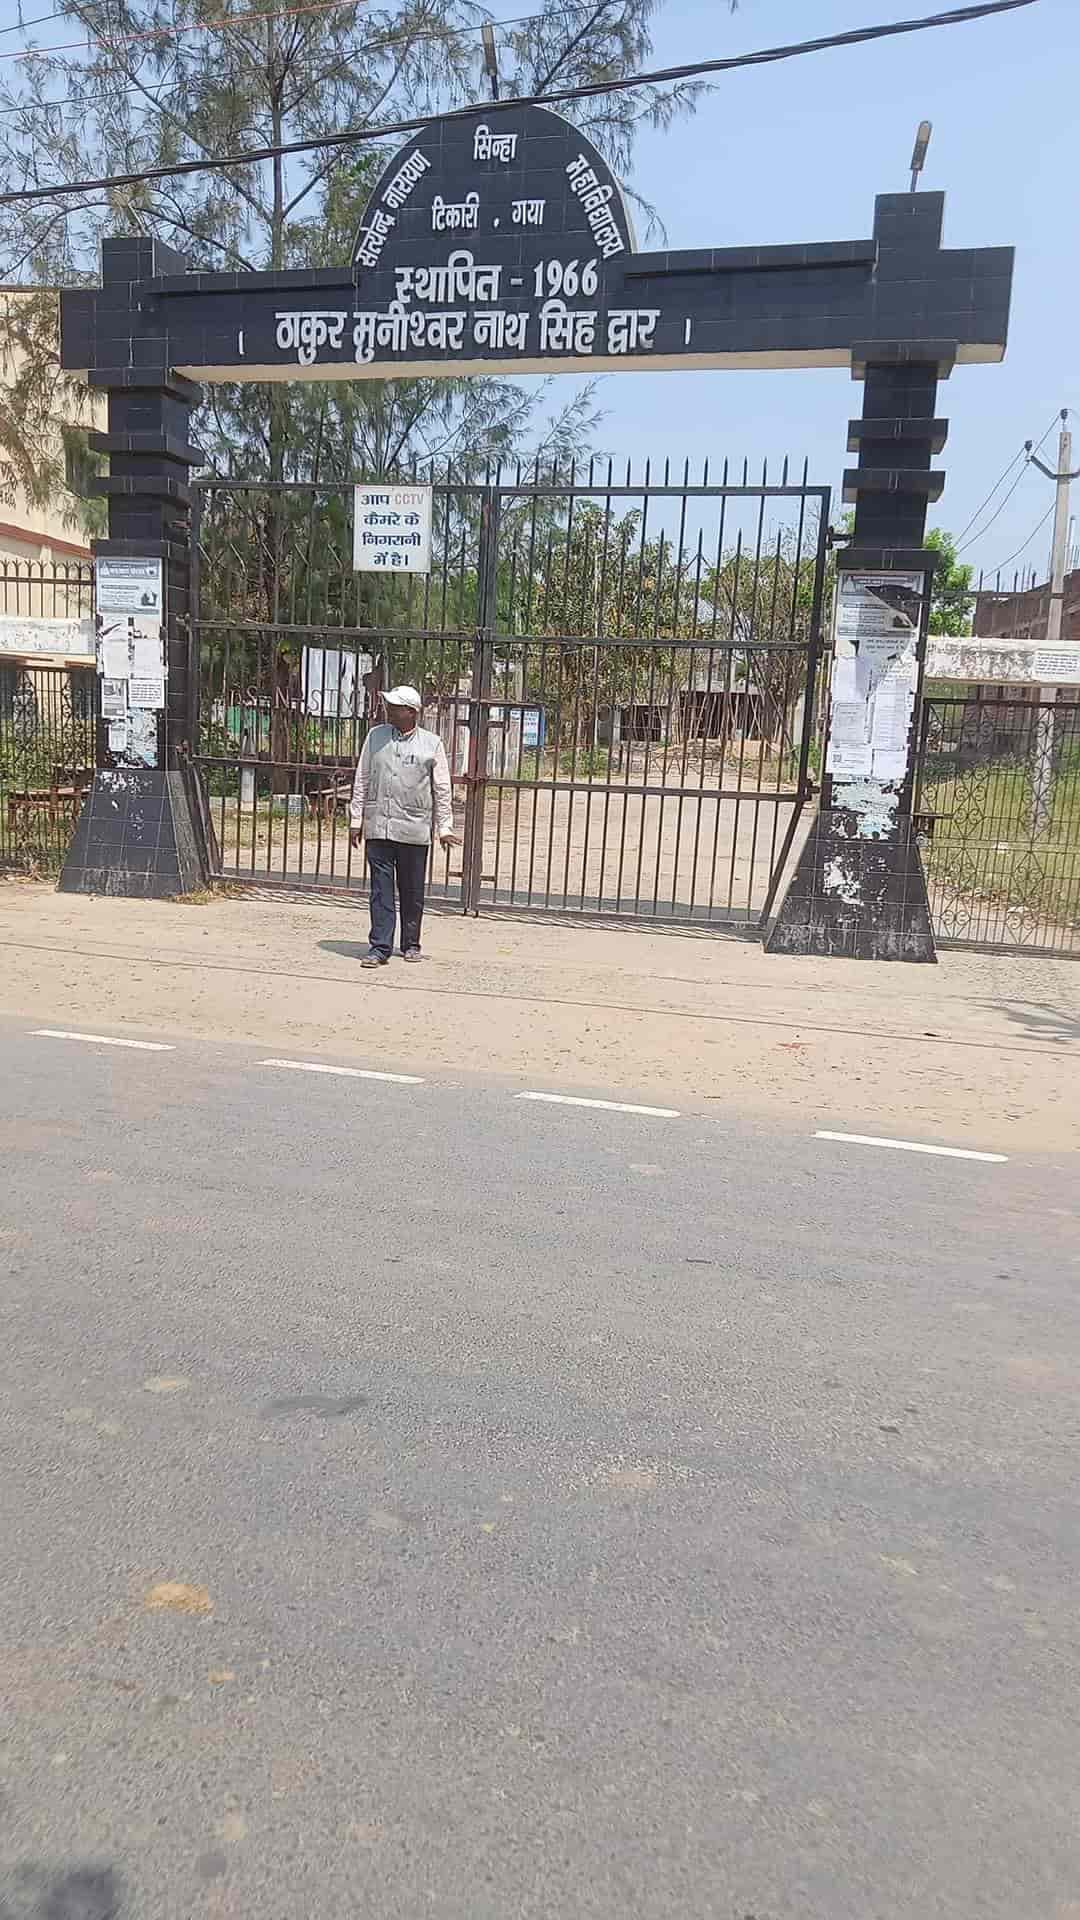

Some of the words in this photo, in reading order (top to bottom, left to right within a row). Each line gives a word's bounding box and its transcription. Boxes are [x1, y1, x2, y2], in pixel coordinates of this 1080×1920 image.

[381, 148, 432, 209] नारायण
[473, 124, 518, 163] सिन्हा
[565, 153, 625, 259] महाविद्यालय
[431, 191, 480, 231] टिकारी
[511, 199, 546, 226] गया
[394, 249, 503, 303] स्थापित
[533, 258, 599, 297] 1966
[275, 311, 348, 366] ठाकुर
[352, 300, 467, 364] मुनीश्वर
[473, 309, 530, 350] नाथ
[607, 309, 661, 354] द्वार
[360, 494, 391, 505] आप
[394, 493, 424, 505] CCTV
[403, 511, 421, 526] के
[362, 531, 421, 546] निगरानी
[373, 551, 389, 566] में
